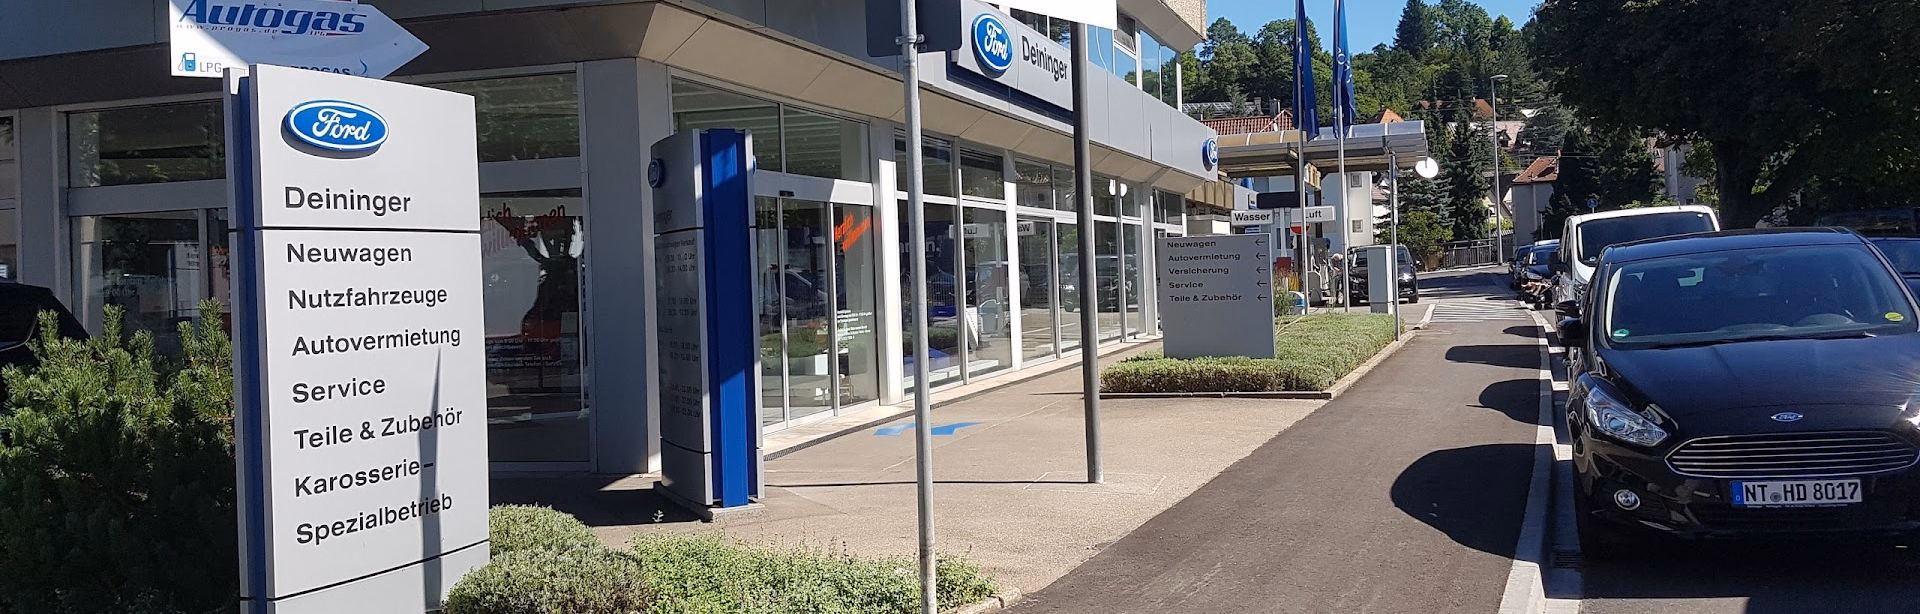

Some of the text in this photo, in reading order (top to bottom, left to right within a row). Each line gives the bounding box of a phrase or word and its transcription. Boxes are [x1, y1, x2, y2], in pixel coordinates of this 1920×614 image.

[179, 0, 368, 34] Autogas
[985, 22, 1067, 81] Ford Deininger
[200, 63, 222, 73] LPG
[311, 108, 371, 141] Ford
[285, 186, 411, 217] Deininger
[1234, 212, 1270, 221] Wasser
[286, 243, 412, 266] Neuwagen
[1167, 240, 1217, 249] Neuwagen
[1168, 253, 1241, 262] Autovermietung
[1168, 266, 1229, 275] Versicherung
[1168, 281, 1204, 289] Service
[288, 287, 448, 309] Nutzfahrzeuge
[1201, 294, 1242, 302] Zubehör
[292, 328, 461, 356] Autovermietung
[292, 377, 386, 403] Service
[294, 407, 463, 449] Teile & Zubehör
[295, 458, 434, 497] Karosserie-
[1745, 485, 1767, 501] NT
[1783, 484, 1807, 501] HD
[1814, 483, 1859, 500] 8017
[296, 493, 453, 545] Spezialbetrieb
